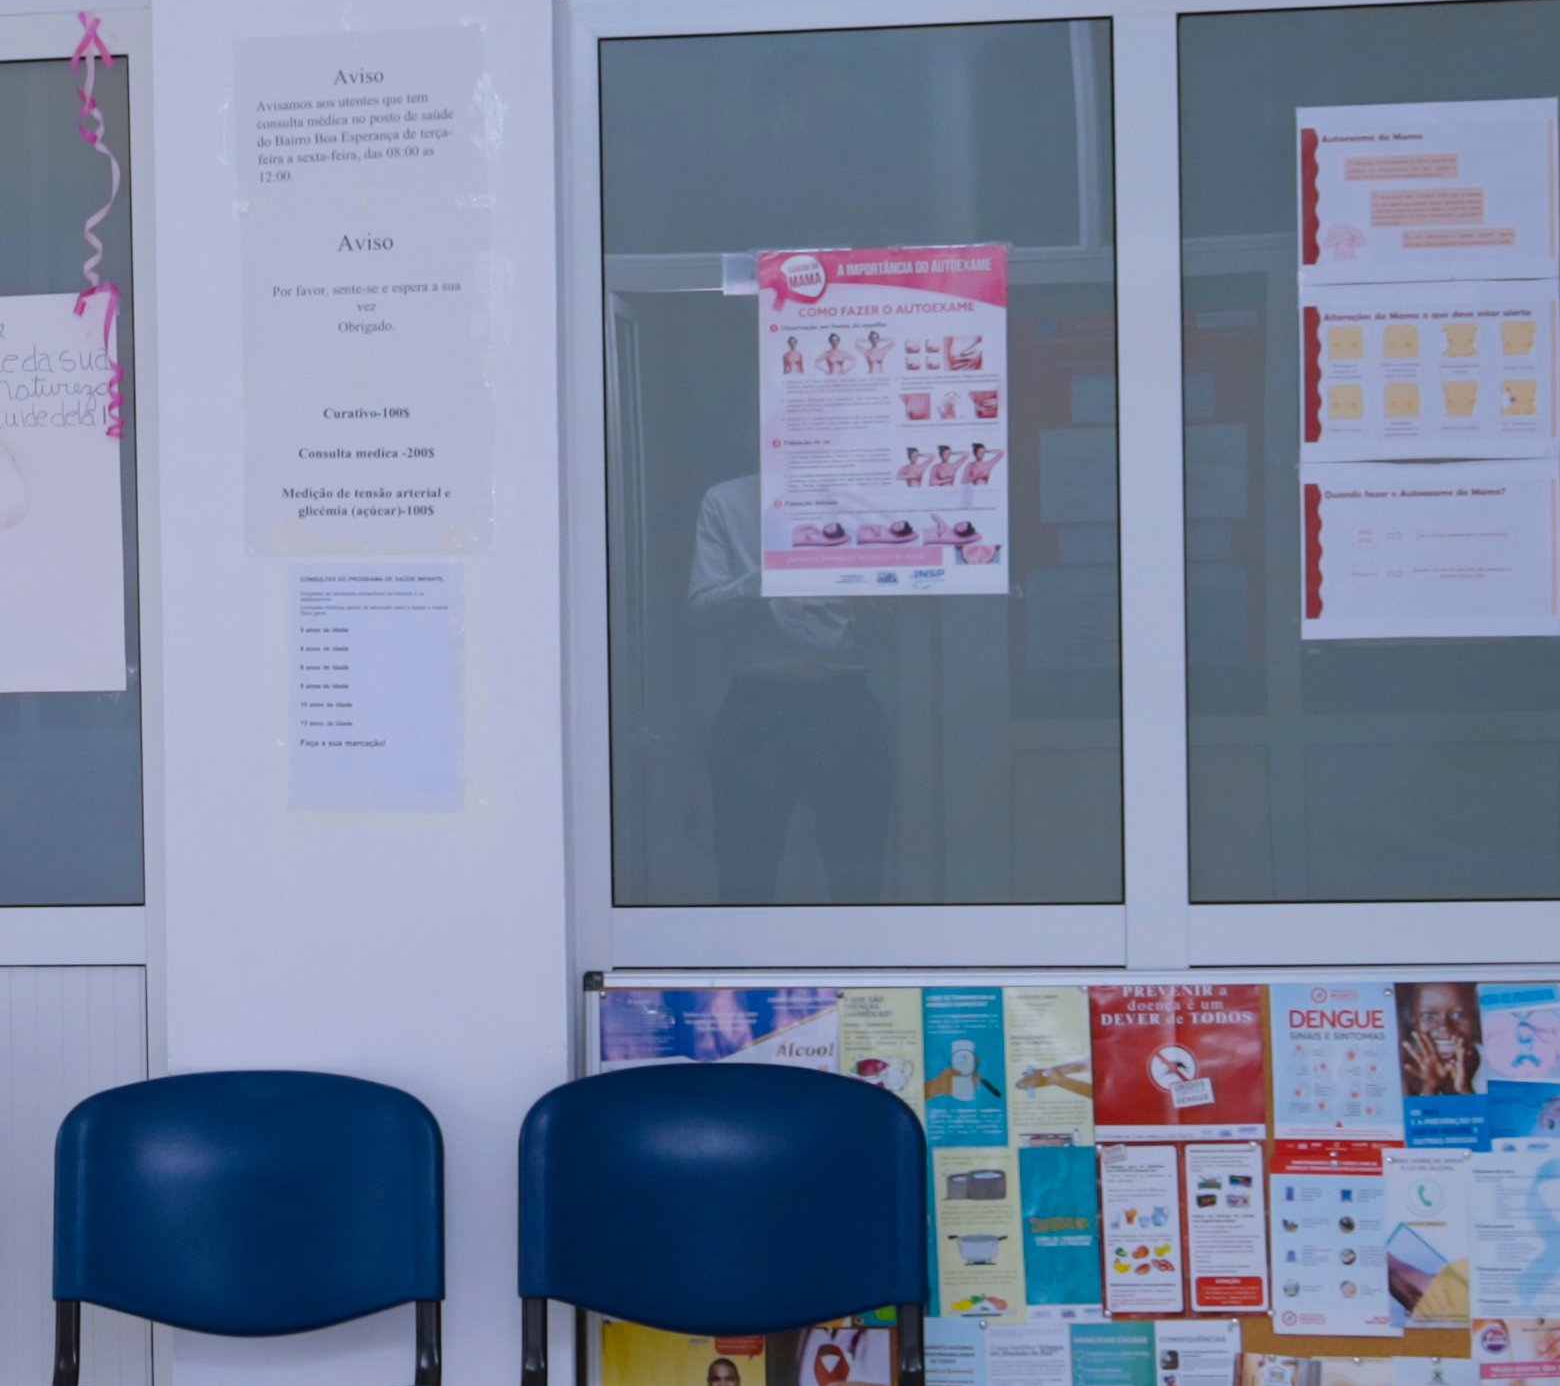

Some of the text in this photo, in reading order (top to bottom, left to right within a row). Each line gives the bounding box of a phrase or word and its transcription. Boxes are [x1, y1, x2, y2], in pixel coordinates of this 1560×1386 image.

[333, 67, 384, 85] Aviso
[256, 93, 429, 113] Avisamos aos utentes que tem
[256, 109, 454, 131] consulta médica no posto de saúde
[257, 127, 453, 148] do Bairro Boa Esperança de terça-
[1321, 132, 1423, 143] Autoexame da Mama
[258, 152, 284, 166] feira
[287, 154, 294, 164] a
[296, 149, 361, 164] sexta-feira,
[363, 147, 384, 159] das
[386, 146, 420, 158] 08:00
[258, 171, 295, 184] 12:00.
[337, 233, 394, 252] Aviso
[837, 258, 993, 277] A IMPORTÂNCIA DO AUTOEXAME
[788, 271, 822, 288] MAMA
[272, 282, 462, 298] Por favor, sente-se e espera a sua
[356, 302, 377, 312] vez
[798, 302, 976, 318] COMO FAZER O AUTOEXAME
[337, 320, 395, 335] Obrigado.
[21, 343, 54, 373] da
[298, 447, 352, 459] Consulta
[355, 447, 398, 459] medica
[282, 487, 452, 500] Medição de tensão arterial e
[300, 739, 320, 749] Faça
[344, 739, 387, 749] marcação!
[1121, 985, 1228, 998] PREVENIR a
[1126, 999, 1224, 1012] doença é um
[1100, 1011, 1253, 1026] DEVER de TODOS
[1288, 1009, 1385, 1029] DENGUE
[1289, 1031, 1386, 1041] SINAIS E SINTOMAS
